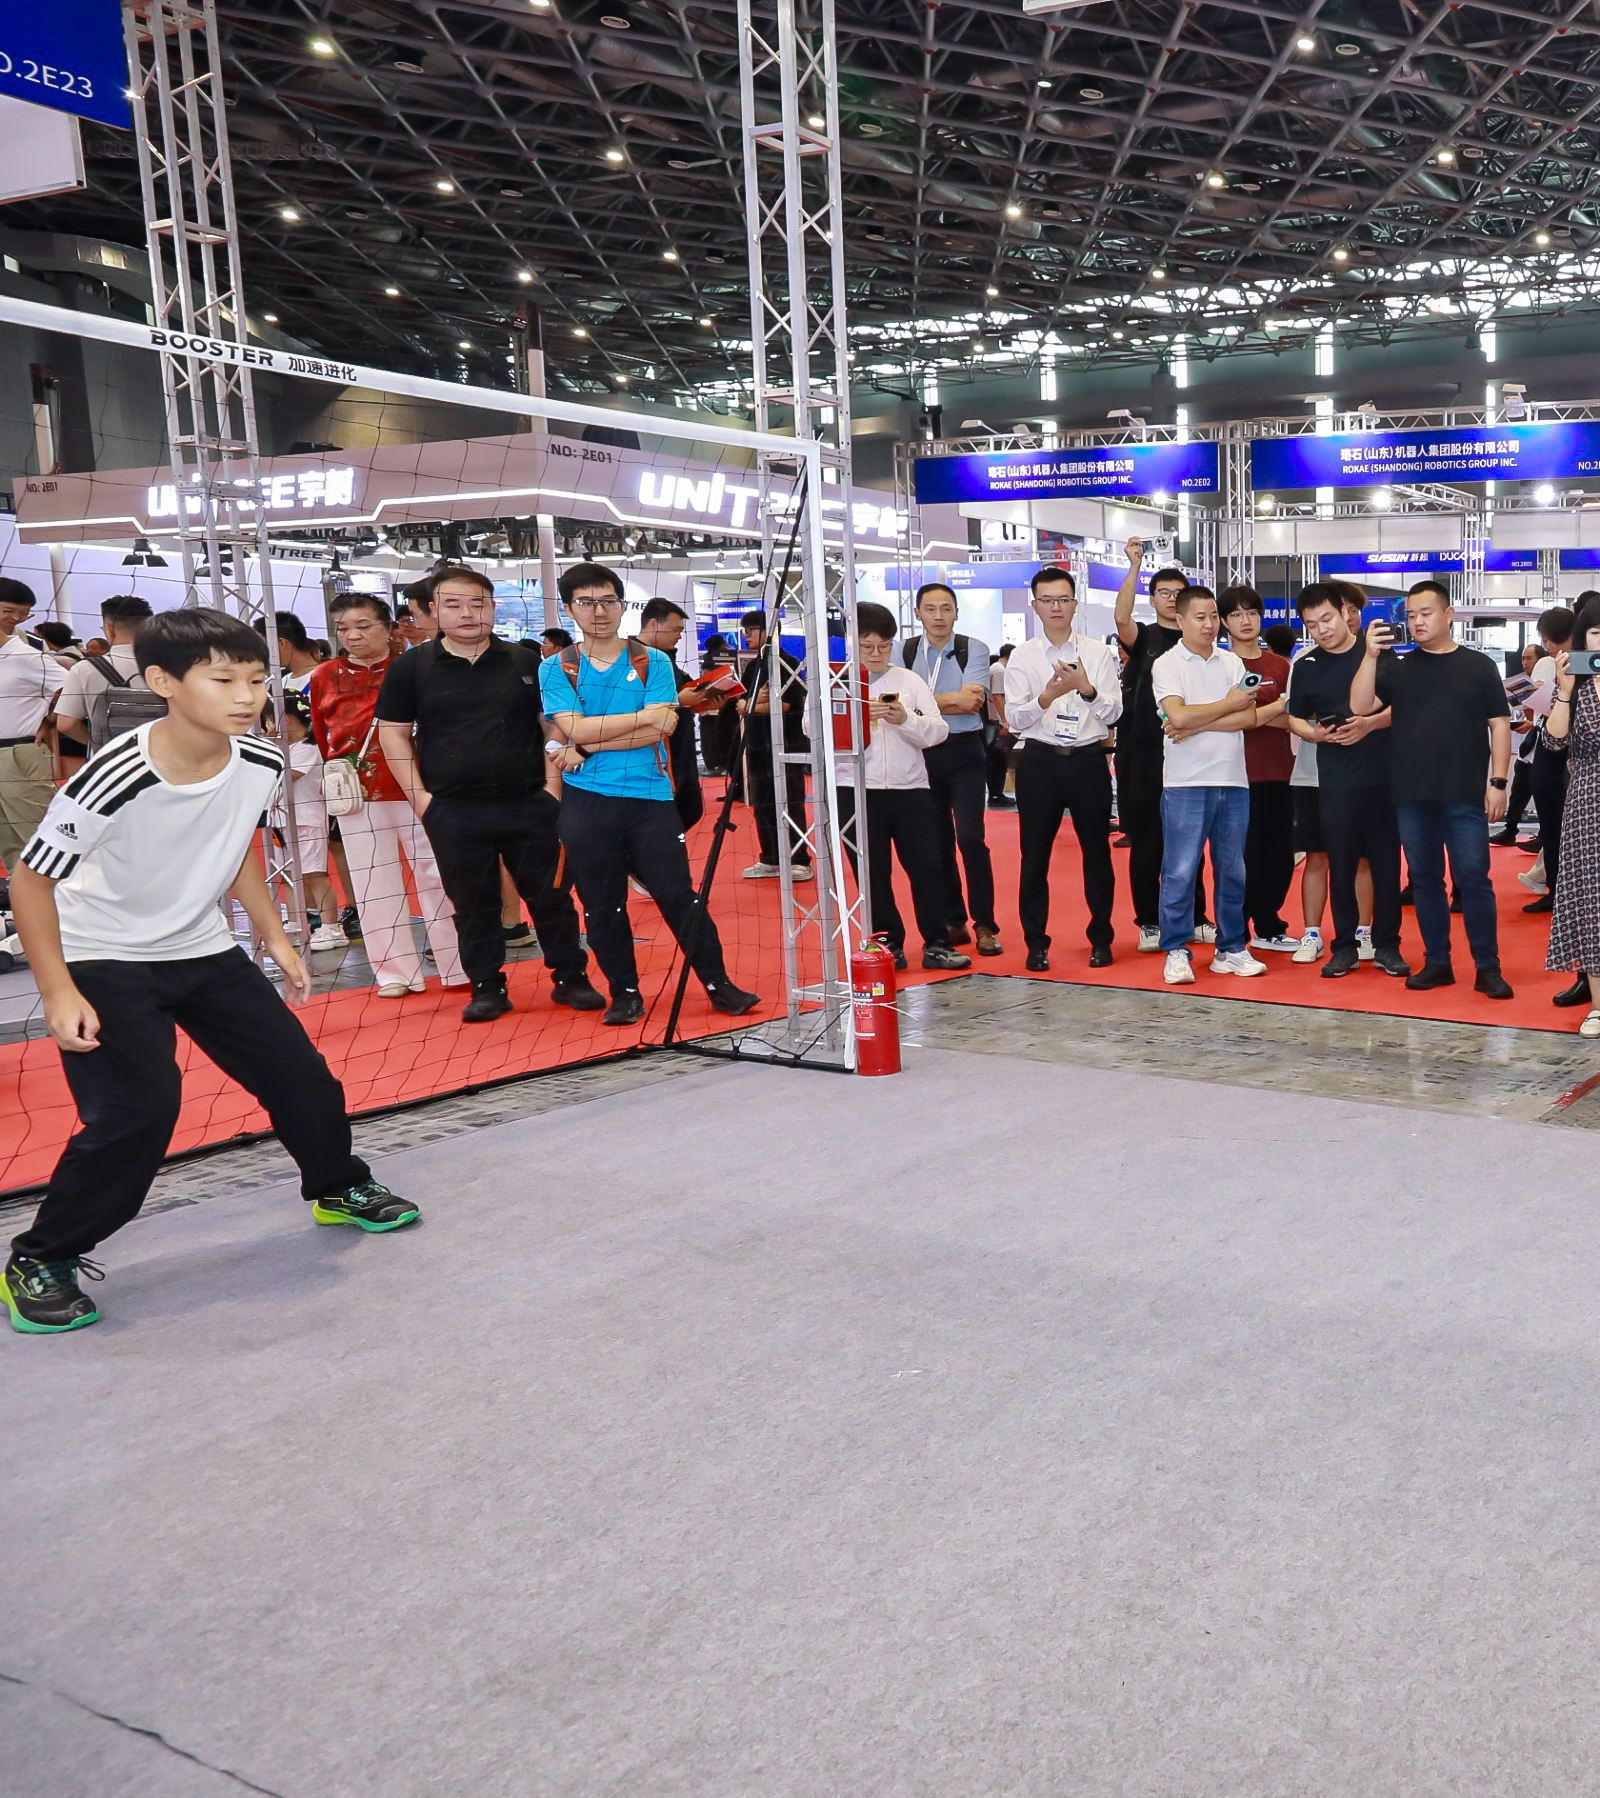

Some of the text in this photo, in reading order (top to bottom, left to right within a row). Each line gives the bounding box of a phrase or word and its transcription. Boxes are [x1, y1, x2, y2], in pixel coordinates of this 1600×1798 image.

[150, 330, 358, 382] BOOSTER 加速进化
[551, 443, 612, 464] NO: 2E01
[1342, 464, 1369, 473] ROKAE
[1370, 462, 1423, 474] (SHANDONG)
[1425, 460, 1466, 470] ROBOTICS
[1468, 459, 1499, 468] GROUP
[1500, 457, 1518, 467] INC.
[990, 474, 1211, 490] ROKAE (SHANDONG) ROBOTICS GROUP INC. NO.2E02
[1367, 553, 1409, 563] SIASUN
